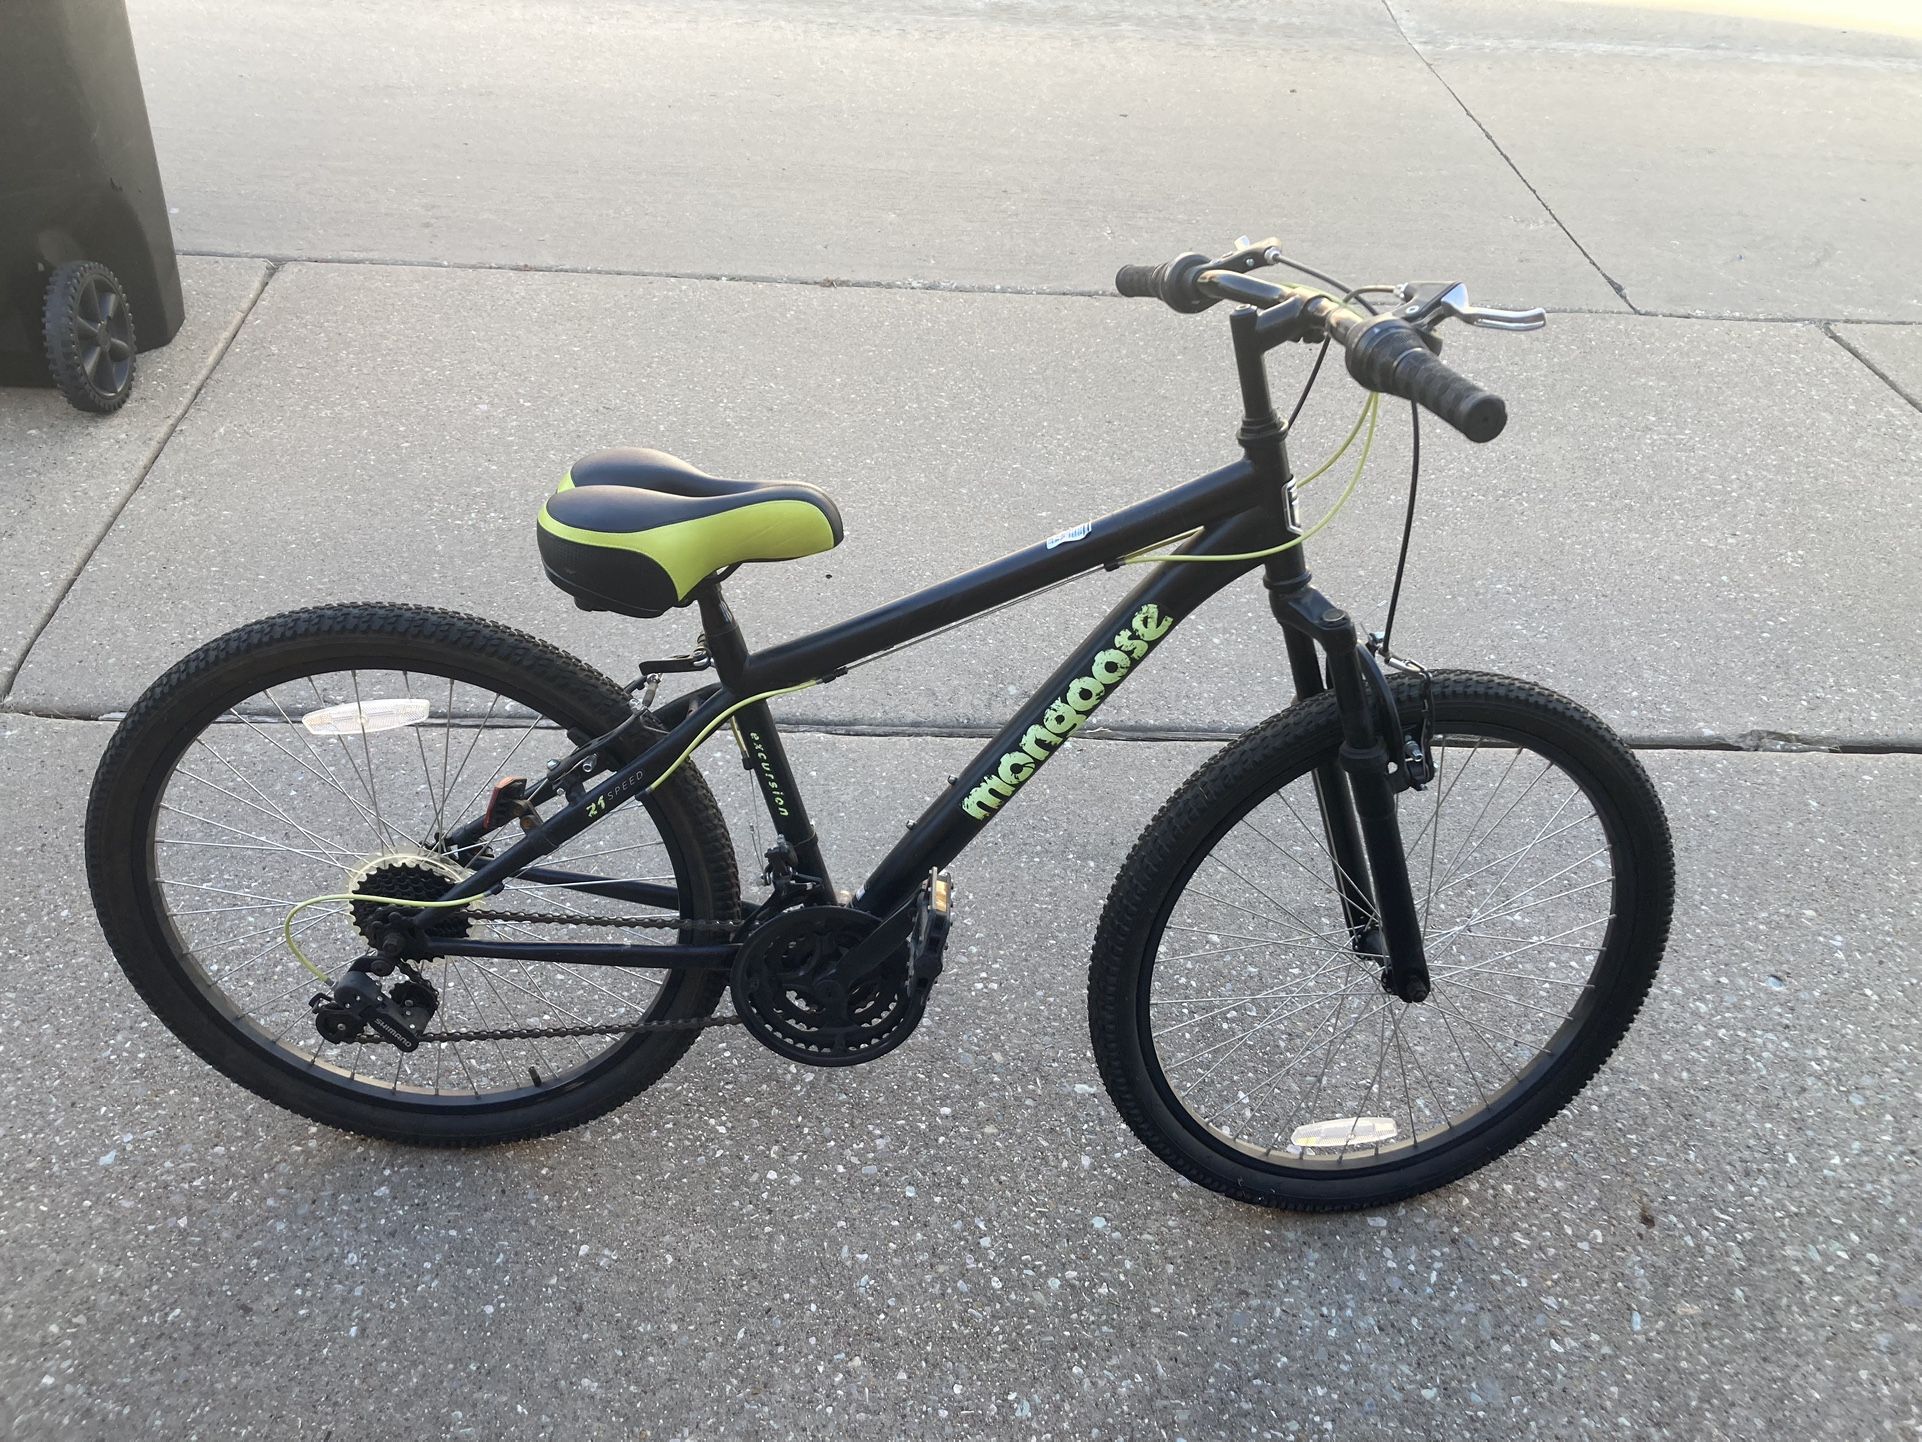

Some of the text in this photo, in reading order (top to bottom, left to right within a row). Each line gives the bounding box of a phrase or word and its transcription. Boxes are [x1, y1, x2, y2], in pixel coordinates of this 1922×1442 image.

[961, 603, 1174, 821] mongoose
[586, 770, 643, 818] 21 SPEED
[750, 732, 789, 816] excursion
[374, 1018, 412, 1048] SHIMANO
